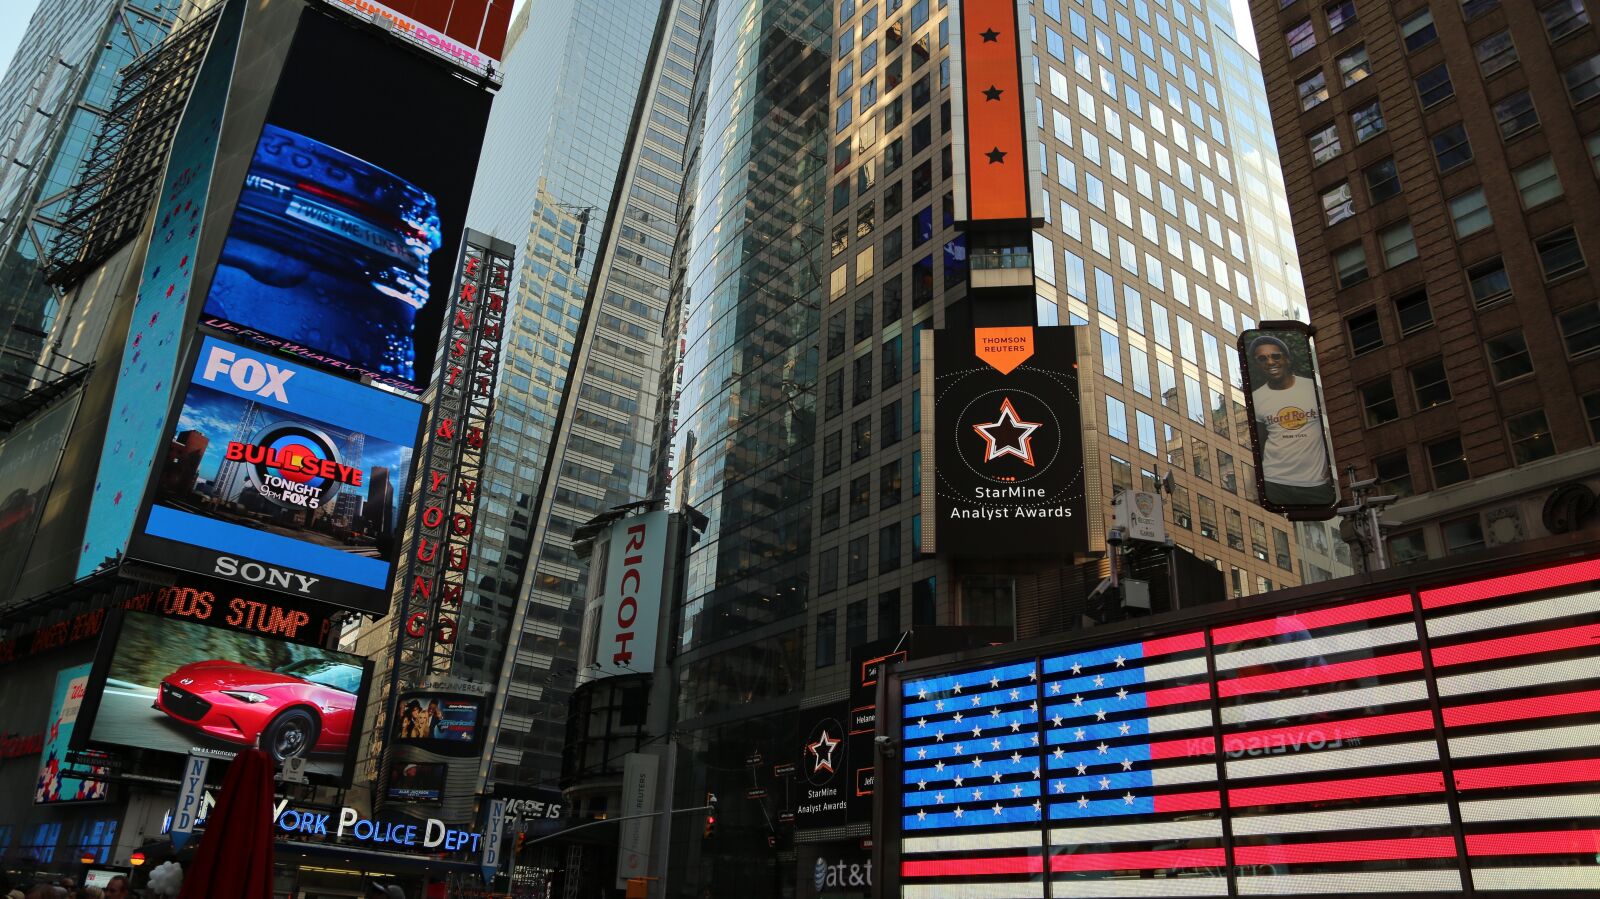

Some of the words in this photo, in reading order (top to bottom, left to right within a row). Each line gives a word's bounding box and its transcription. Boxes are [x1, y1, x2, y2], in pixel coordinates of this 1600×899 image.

[415, 27, 481, 67] DONUTS
[448, 256, 480, 386] ERNST
[984, 345, 1025, 353] REUTERS
[202, 345, 296, 404] FOX
[436, 417, 454, 440] &
[1266, 413, 1290, 424] Hard
[1292, 408, 1317, 420] Rock
[225, 441, 363, 487] BULLSEYE
[260, 484, 281, 500] 9PM
[281, 490, 309, 507] FOX
[308, 497, 320, 509] 5
[263, 473, 323, 498] TONIGHT
[975, 486, 1046, 499] StarMine
[950, 506, 1009, 521] Analyst
[1015, 505, 1072, 518] Awards
[405, 470, 446, 639] YOUNG
[213, 556, 319, 594] SONY
[612, 522, 647, 666] RICOH
[225, 597, 310, 639] STUMP
[177, 760, 206, 831] NYPD
[636, 773, 647, 809] REUTERS
[797, 803, 822, 814] Analyst
[822, 800, 847, 811] Awards
[807, 787, 838, 799] StarMine
[546, 803, 562, 819] IS
[337, 807, 418, 847] POLICE
[423, 818, 481, 853] DEPT
[485, 800, 503, 865] NYPD
